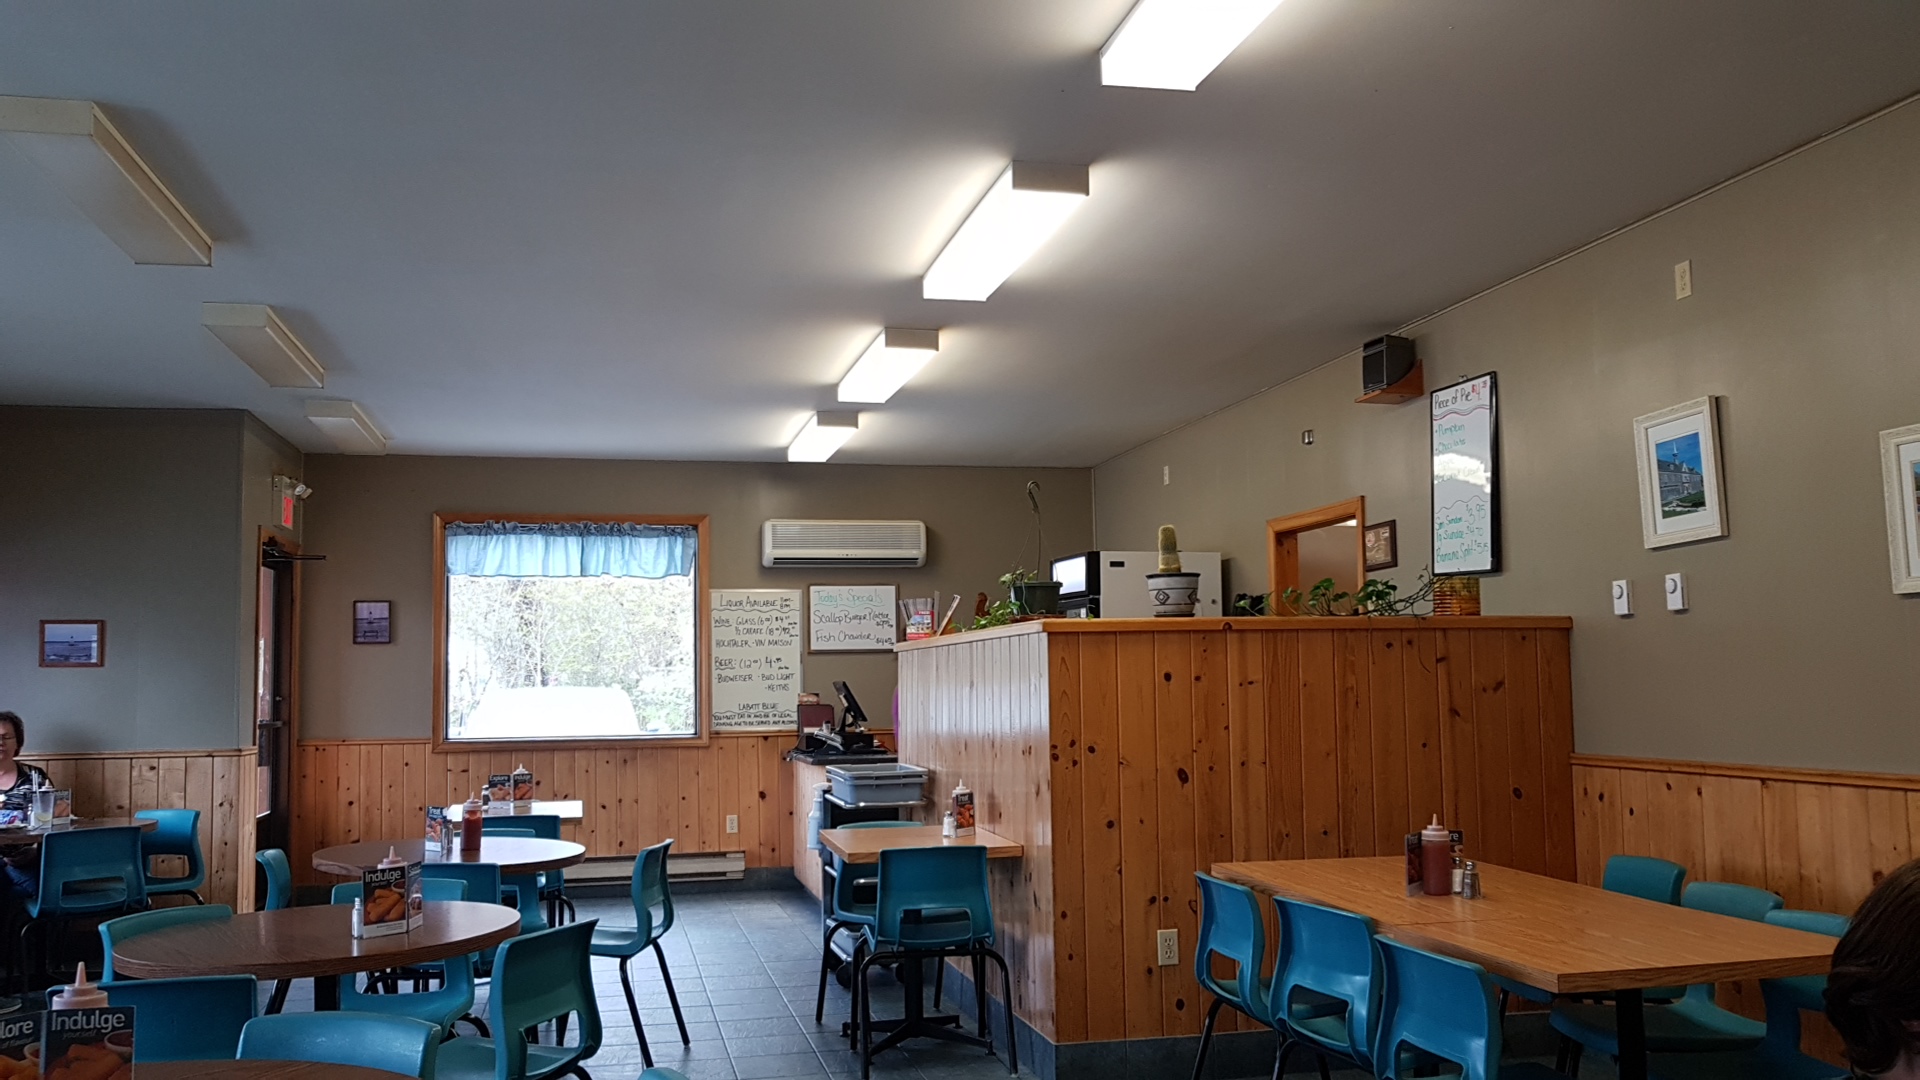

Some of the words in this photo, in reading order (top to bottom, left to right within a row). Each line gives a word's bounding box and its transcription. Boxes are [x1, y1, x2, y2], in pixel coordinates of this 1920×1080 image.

[1434, 394, 1450, 410] Piece
[1451, 389, 1459, 405] of
[1460, 388, 1472, 401] Pie
[720, 594, 744, 608] LIQUOR
[745, 595, 778, 608] AVAILABLE
[736, 616, 756, 625] GLASS
[813, 609, 843, 625] Scallop
[815, 629, 835, 642] Fish
[768, 639, 792, 647] MAISON
[738, 703, 761, 711] LABATT
[762, 702, 779, 710] BLUE
[365, 869, 401, 883] Indulge
[52, 1010, 125, 1033] Indulge
[0, 1020, 33, 1039] lore
[63, 1029, 97, 1039] yourself
